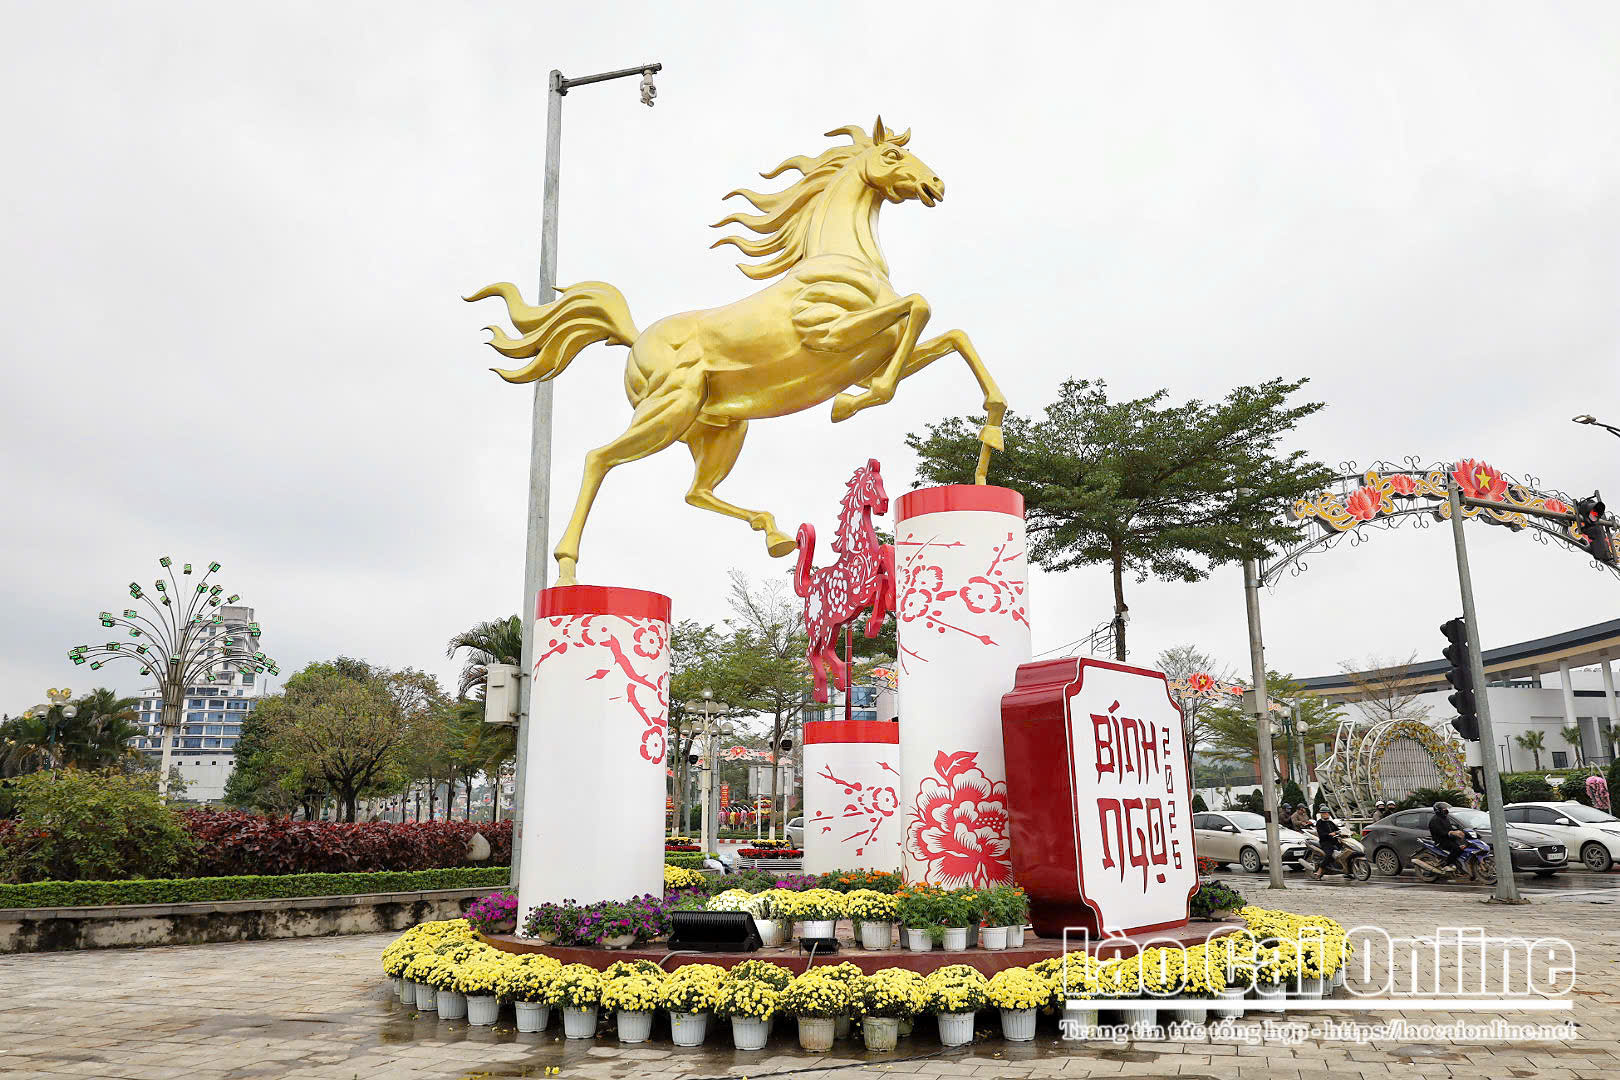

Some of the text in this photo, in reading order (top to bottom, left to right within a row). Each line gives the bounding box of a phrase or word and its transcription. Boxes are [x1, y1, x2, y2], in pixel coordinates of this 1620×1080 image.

[1090, 700, 1160, 784] BÍNH
[1097, 798, 1168, 894] NGỌ
[1162, 727, 1182, 869] 2026
